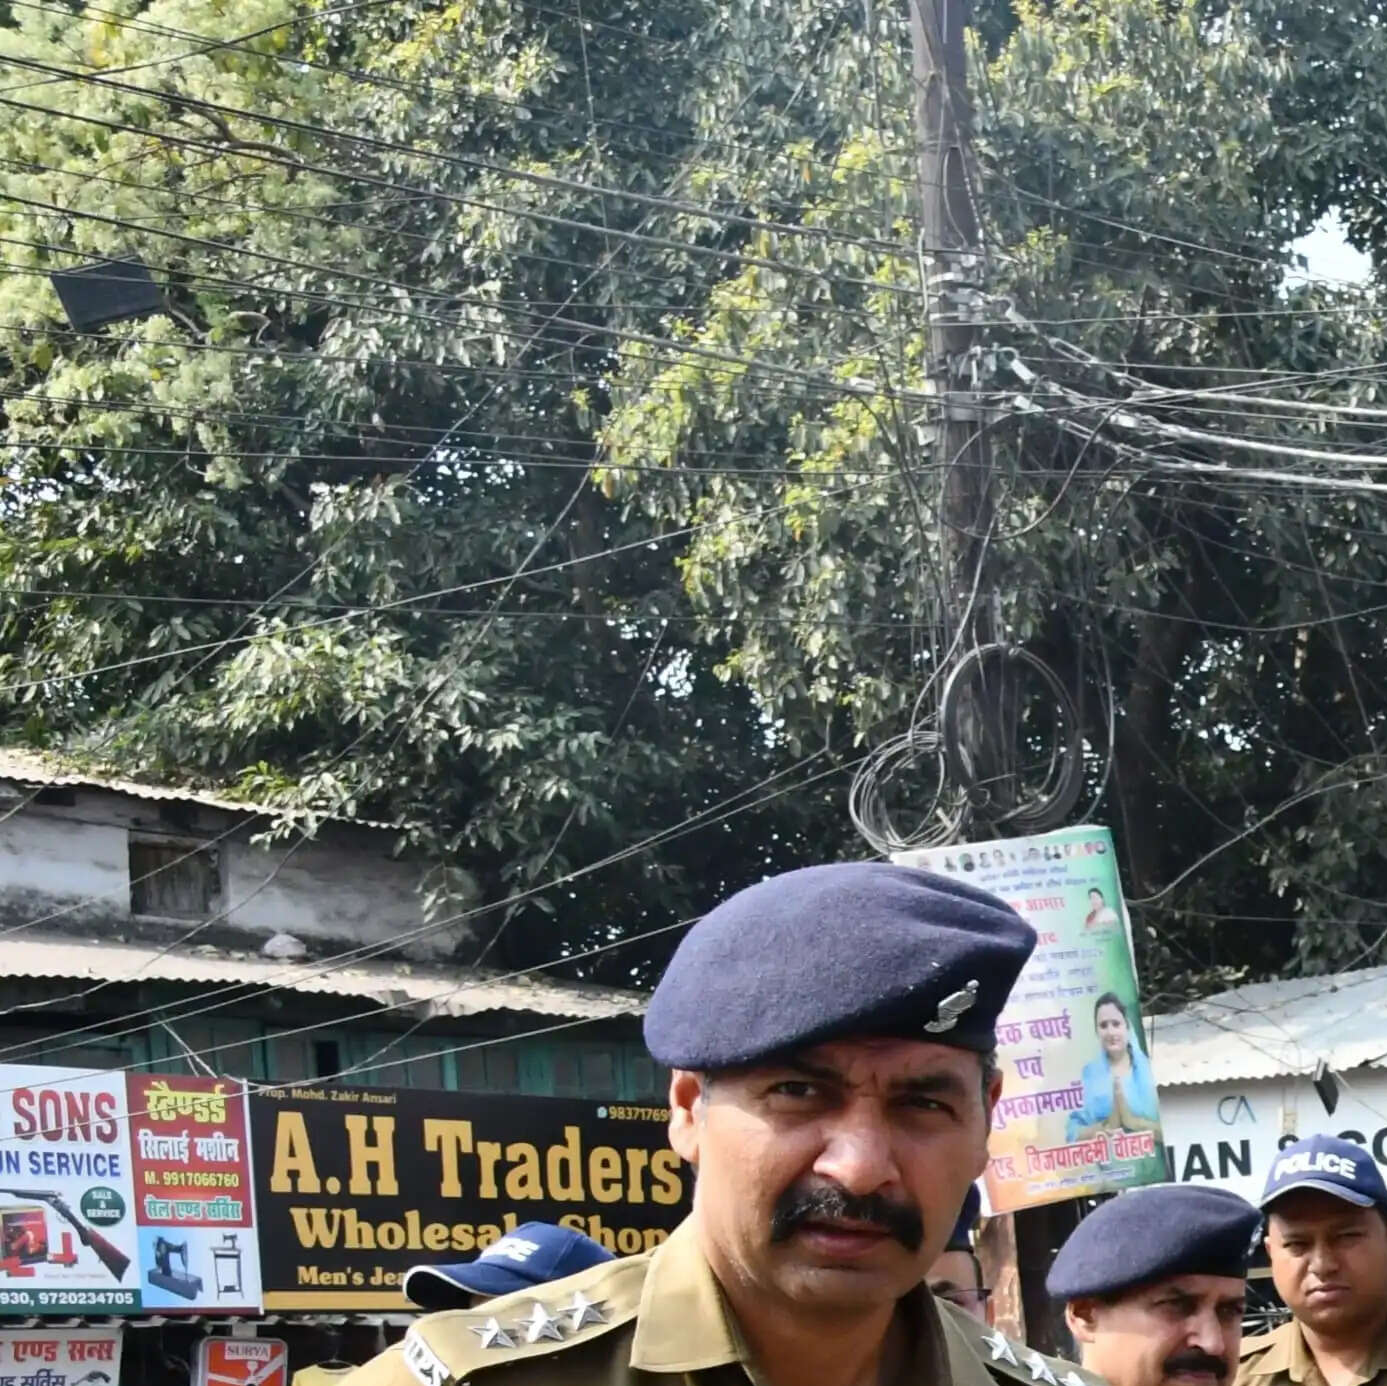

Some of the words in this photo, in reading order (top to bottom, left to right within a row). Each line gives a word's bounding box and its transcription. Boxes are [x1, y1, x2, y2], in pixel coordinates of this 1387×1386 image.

[1025, 1007, 1073, 1043] बधाई
[1013, 1049, 1045, 1080] एवं
[291, 1088, 329, 1100] Mohd.
[331, 1090, 360, 1103] Zakir
[362, 1092, 397, 1105] Ansari
[12, 1087, 119, 1144] SONS
[138, 1128, 190, 1164] सिलाई
[270, 1111, 399, 1196] A.H
[424, 1118, 683, 1205] Traders
[29, 1150, 121, 1178] SERVICE
[144, 1171, 160, 1185] M.
[1274, 1151, 1357, 1182] POLICE
[297, 1265, 364, 1287] Men's
[38, 1291, 135, 1306] 9720234705
[12, 1340, 60, 1363] एण्ड
[66, 1339, 117, 1363] सन्स
[226, 1342, 270, 1358] SURYA
